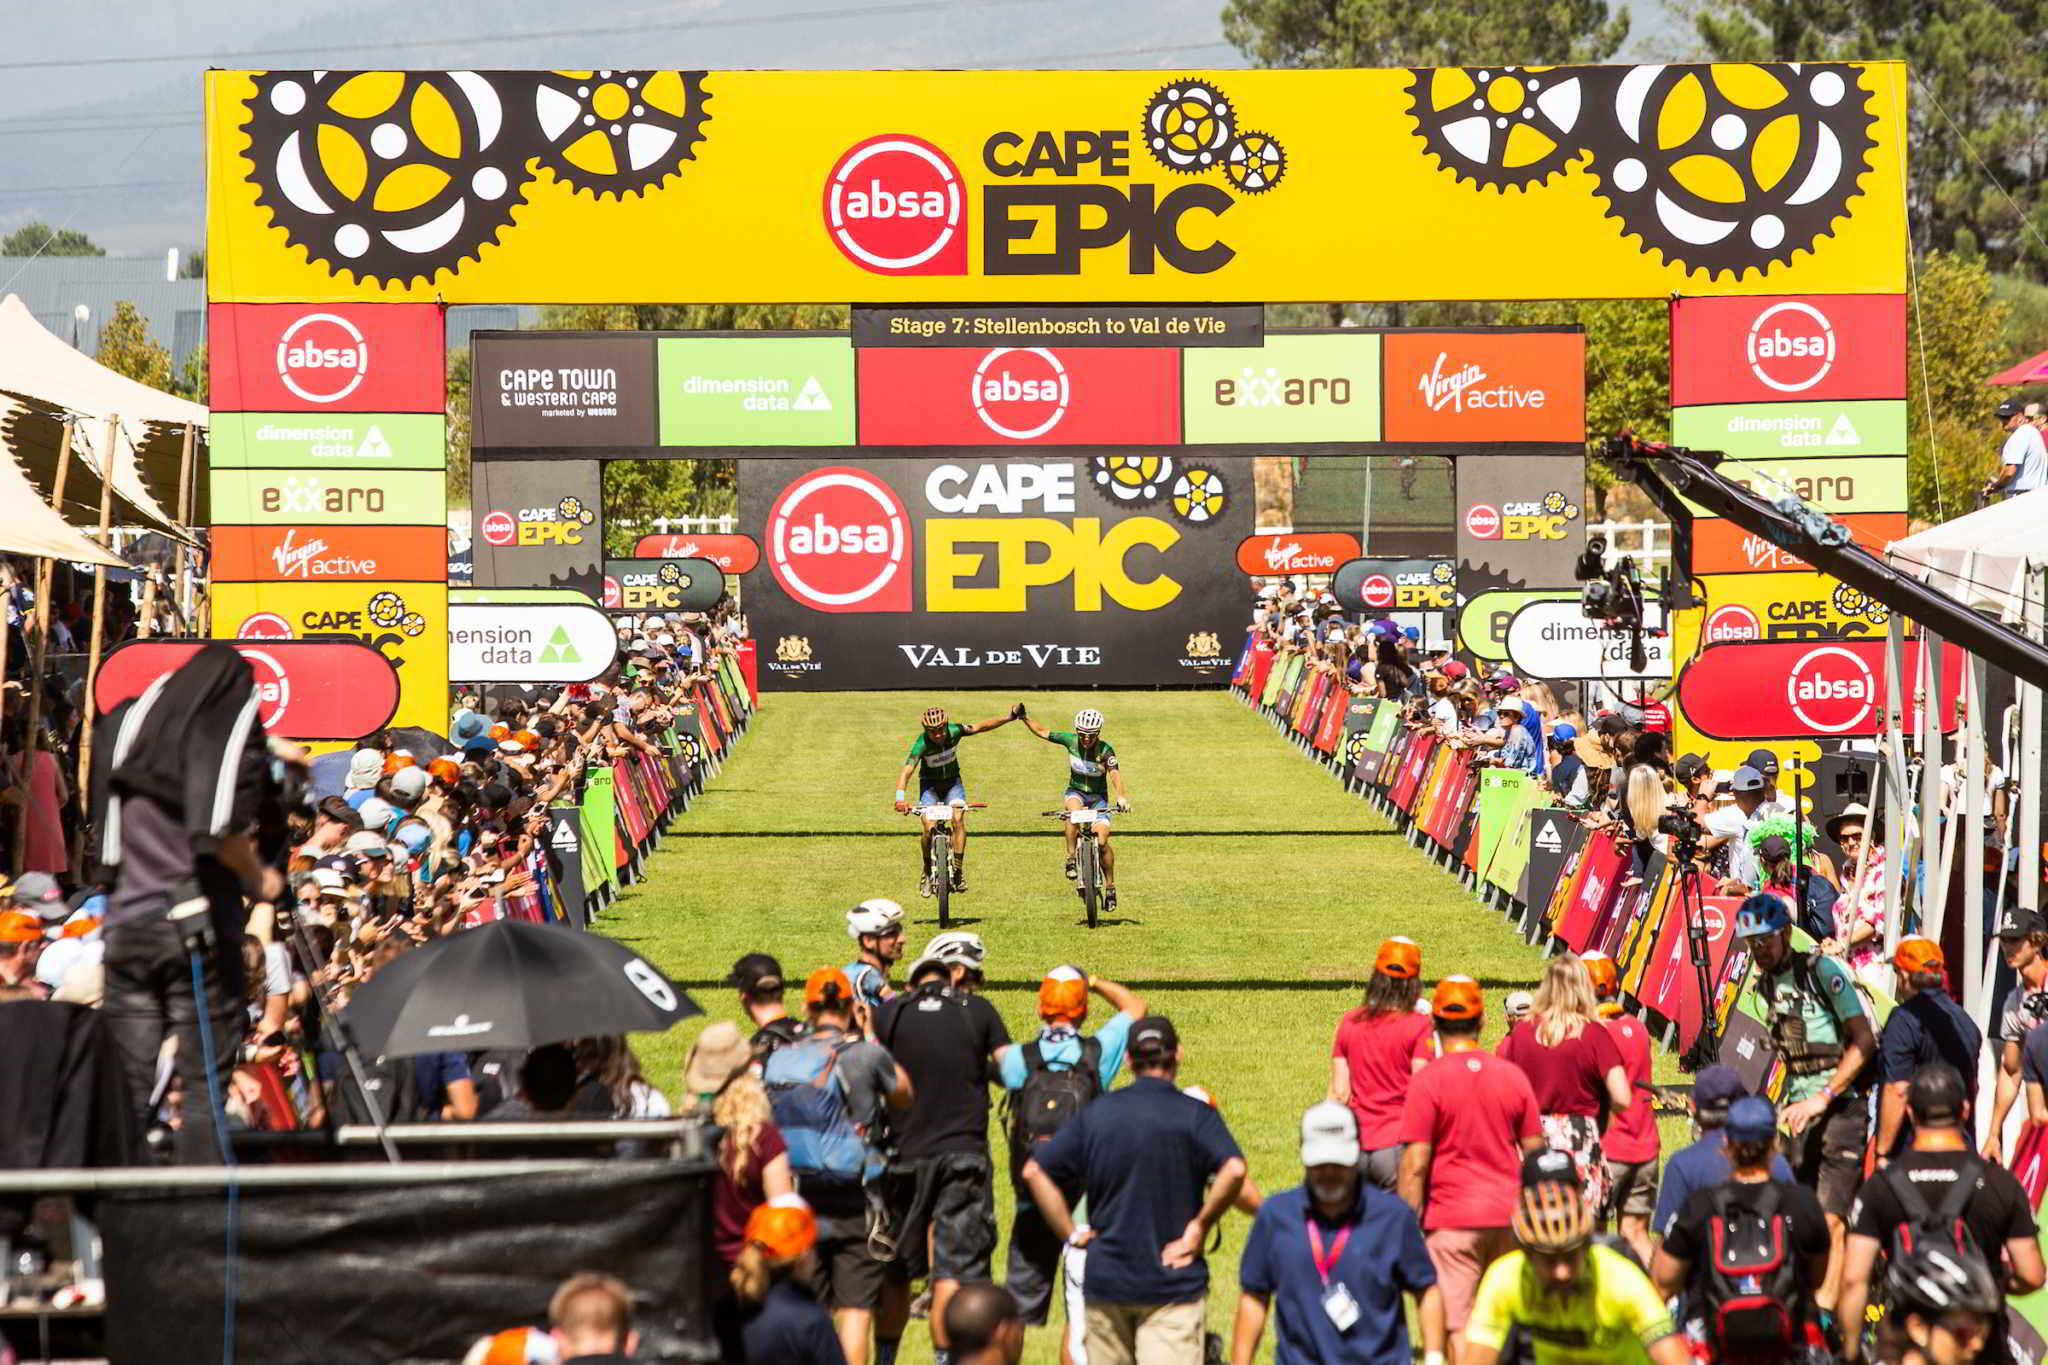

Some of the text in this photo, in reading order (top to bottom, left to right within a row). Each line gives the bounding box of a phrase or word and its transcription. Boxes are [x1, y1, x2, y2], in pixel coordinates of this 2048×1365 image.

[982, 130, 1130, 178] CAPE
[846, 179, 945, 219] absa
[982, 183, 1237, 276] EPIC
[890, 315, 1226, 337] Stage 7: Stellenbosch to Val de Vie
[287, 339, 358, 369] absa
[1758, 329, 1831, 358] absa
[683, 375, 789, 394] dimension
[983, 371, 1059, 402] absa
[1215, 366, 1352, 408] exxaro
[1418, 352, 1487, 413] Virgin
[500, 392, 512, 407] &
[743, 393, 790, 411] data
[1467, 384, 1546, 410] active
[255, 423, 354, 442] dimension
[1727, 414, 1823, 434] dimension
[310, 440, 354, 458] data
[1780, 428, 1823, 447] data
[261, 476, 385, 513] exxaro
[924, 463, 1077, 515] CAPE
[517, 507, 557, 522] CAPE
[1503, 502, 1542, 516] CAPE
[486, 520, 511, 533] absa
[518, 521, 584, 546] EPIC
[788, 511, 890, 555] absa
[1503, 514, 1569, 540] EPIC
[271, 529, 329, 578] Virgin
[310, 555, 377, 576] active
[925, 516, 1184, 613] EPIC
[1264, 536, 1303, 571] Virgin
[1290, 554, 1335, 569] active
[622, 574, 658, 586] CAPE
[1395, 573, 1431, 586] CAPE
[623, 585, 681, 609] EPIC
[1395, 584, 1456, 608] EPIC
[302, 611, 362, 630] CAPE
[1767, 600, 1827, 620] CAPE
[1713, 622, 1753, 640] absa
[481, 646, 532, 664] data
[898, 643, 1101, 669] VAL DE VIE
[1798, 672, 1865, 701] absa
